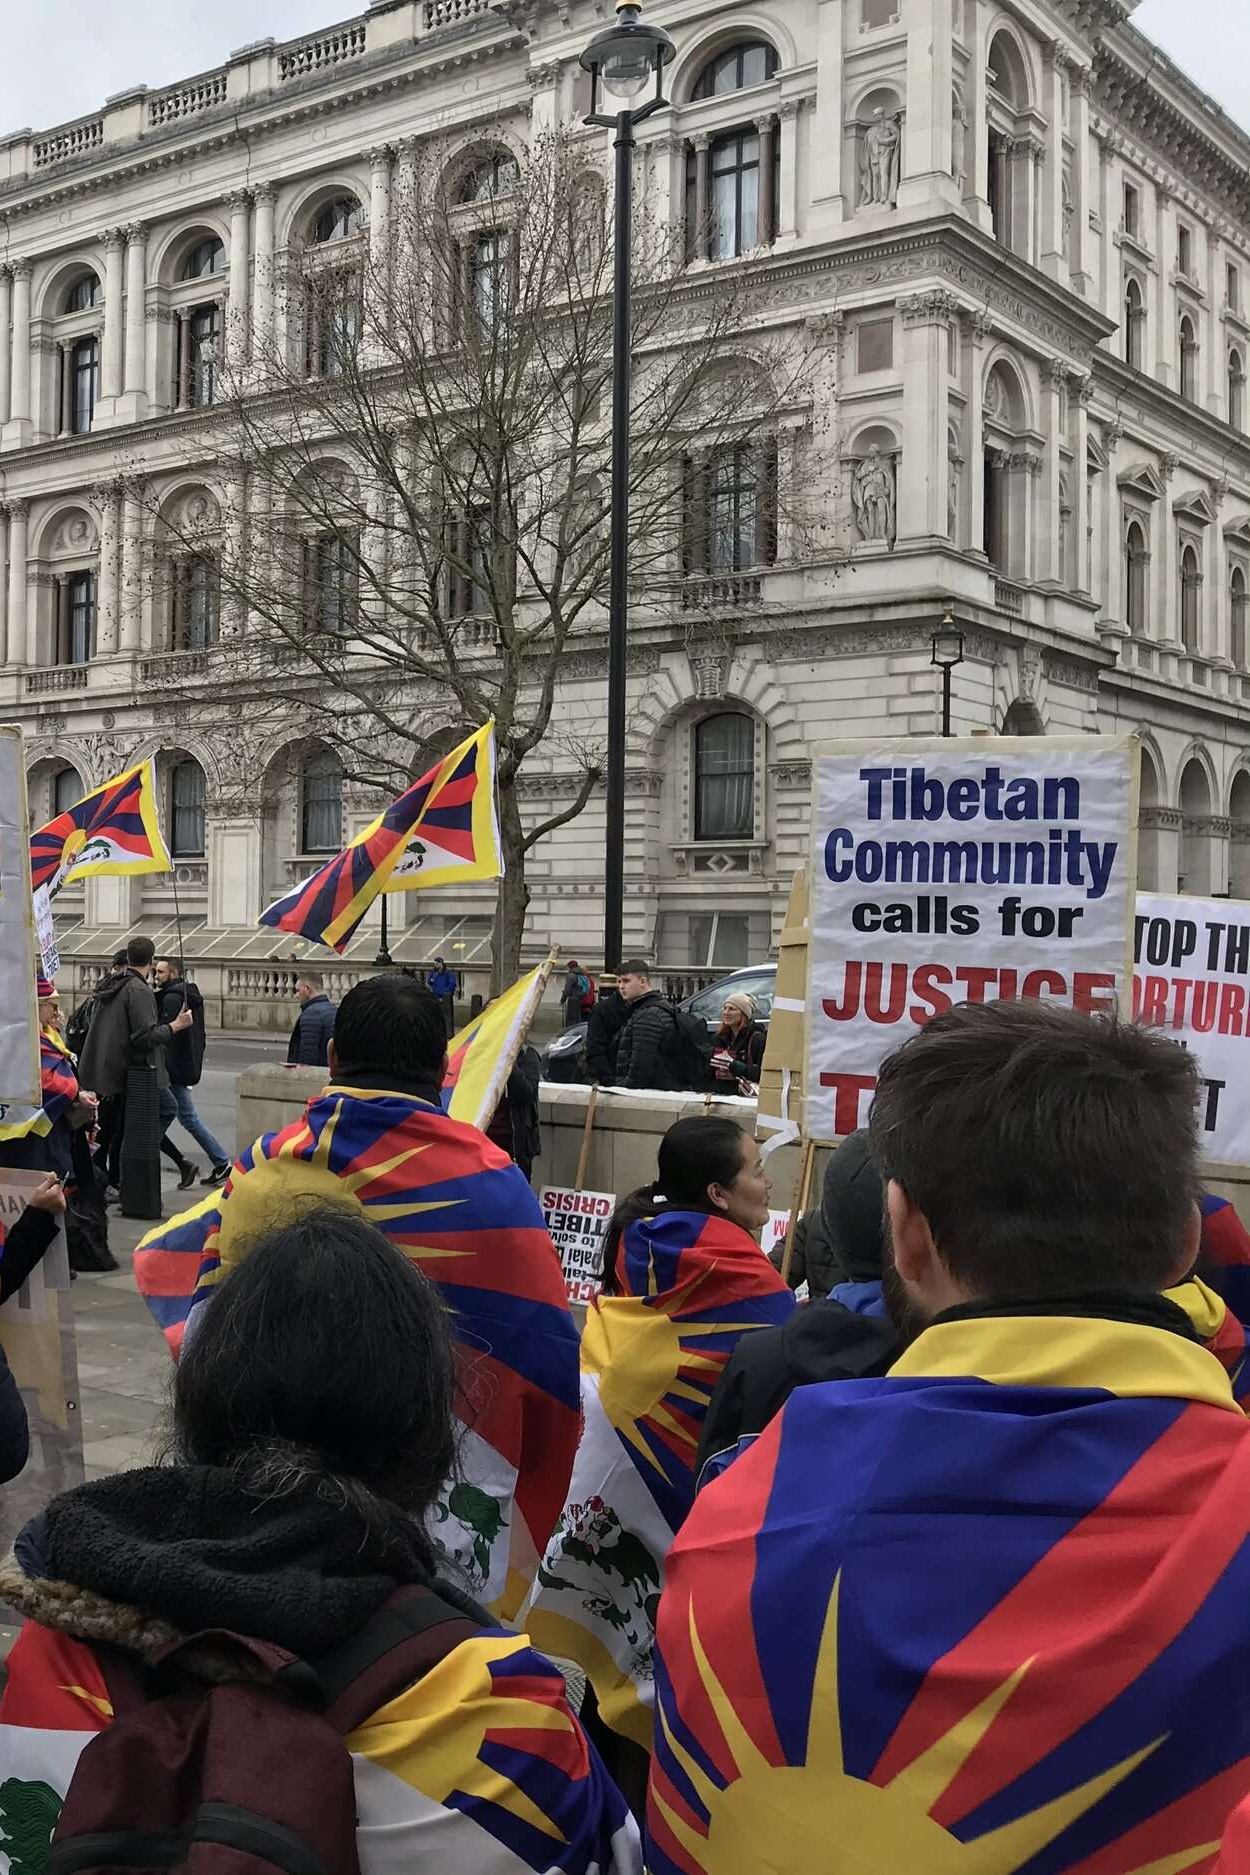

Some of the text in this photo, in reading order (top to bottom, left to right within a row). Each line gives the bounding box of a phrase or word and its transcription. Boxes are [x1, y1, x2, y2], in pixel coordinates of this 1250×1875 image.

[859, 767, 1080, 821] Tibetan
[824, 828, 1118, 899] Community
[852, 896, 1084, 938] calls for
[1132, 975, 1250, 1038] RTUR
[542, 1191, 610, 1217] CRISIS
[549, 1231, 595, 1249] to solv
